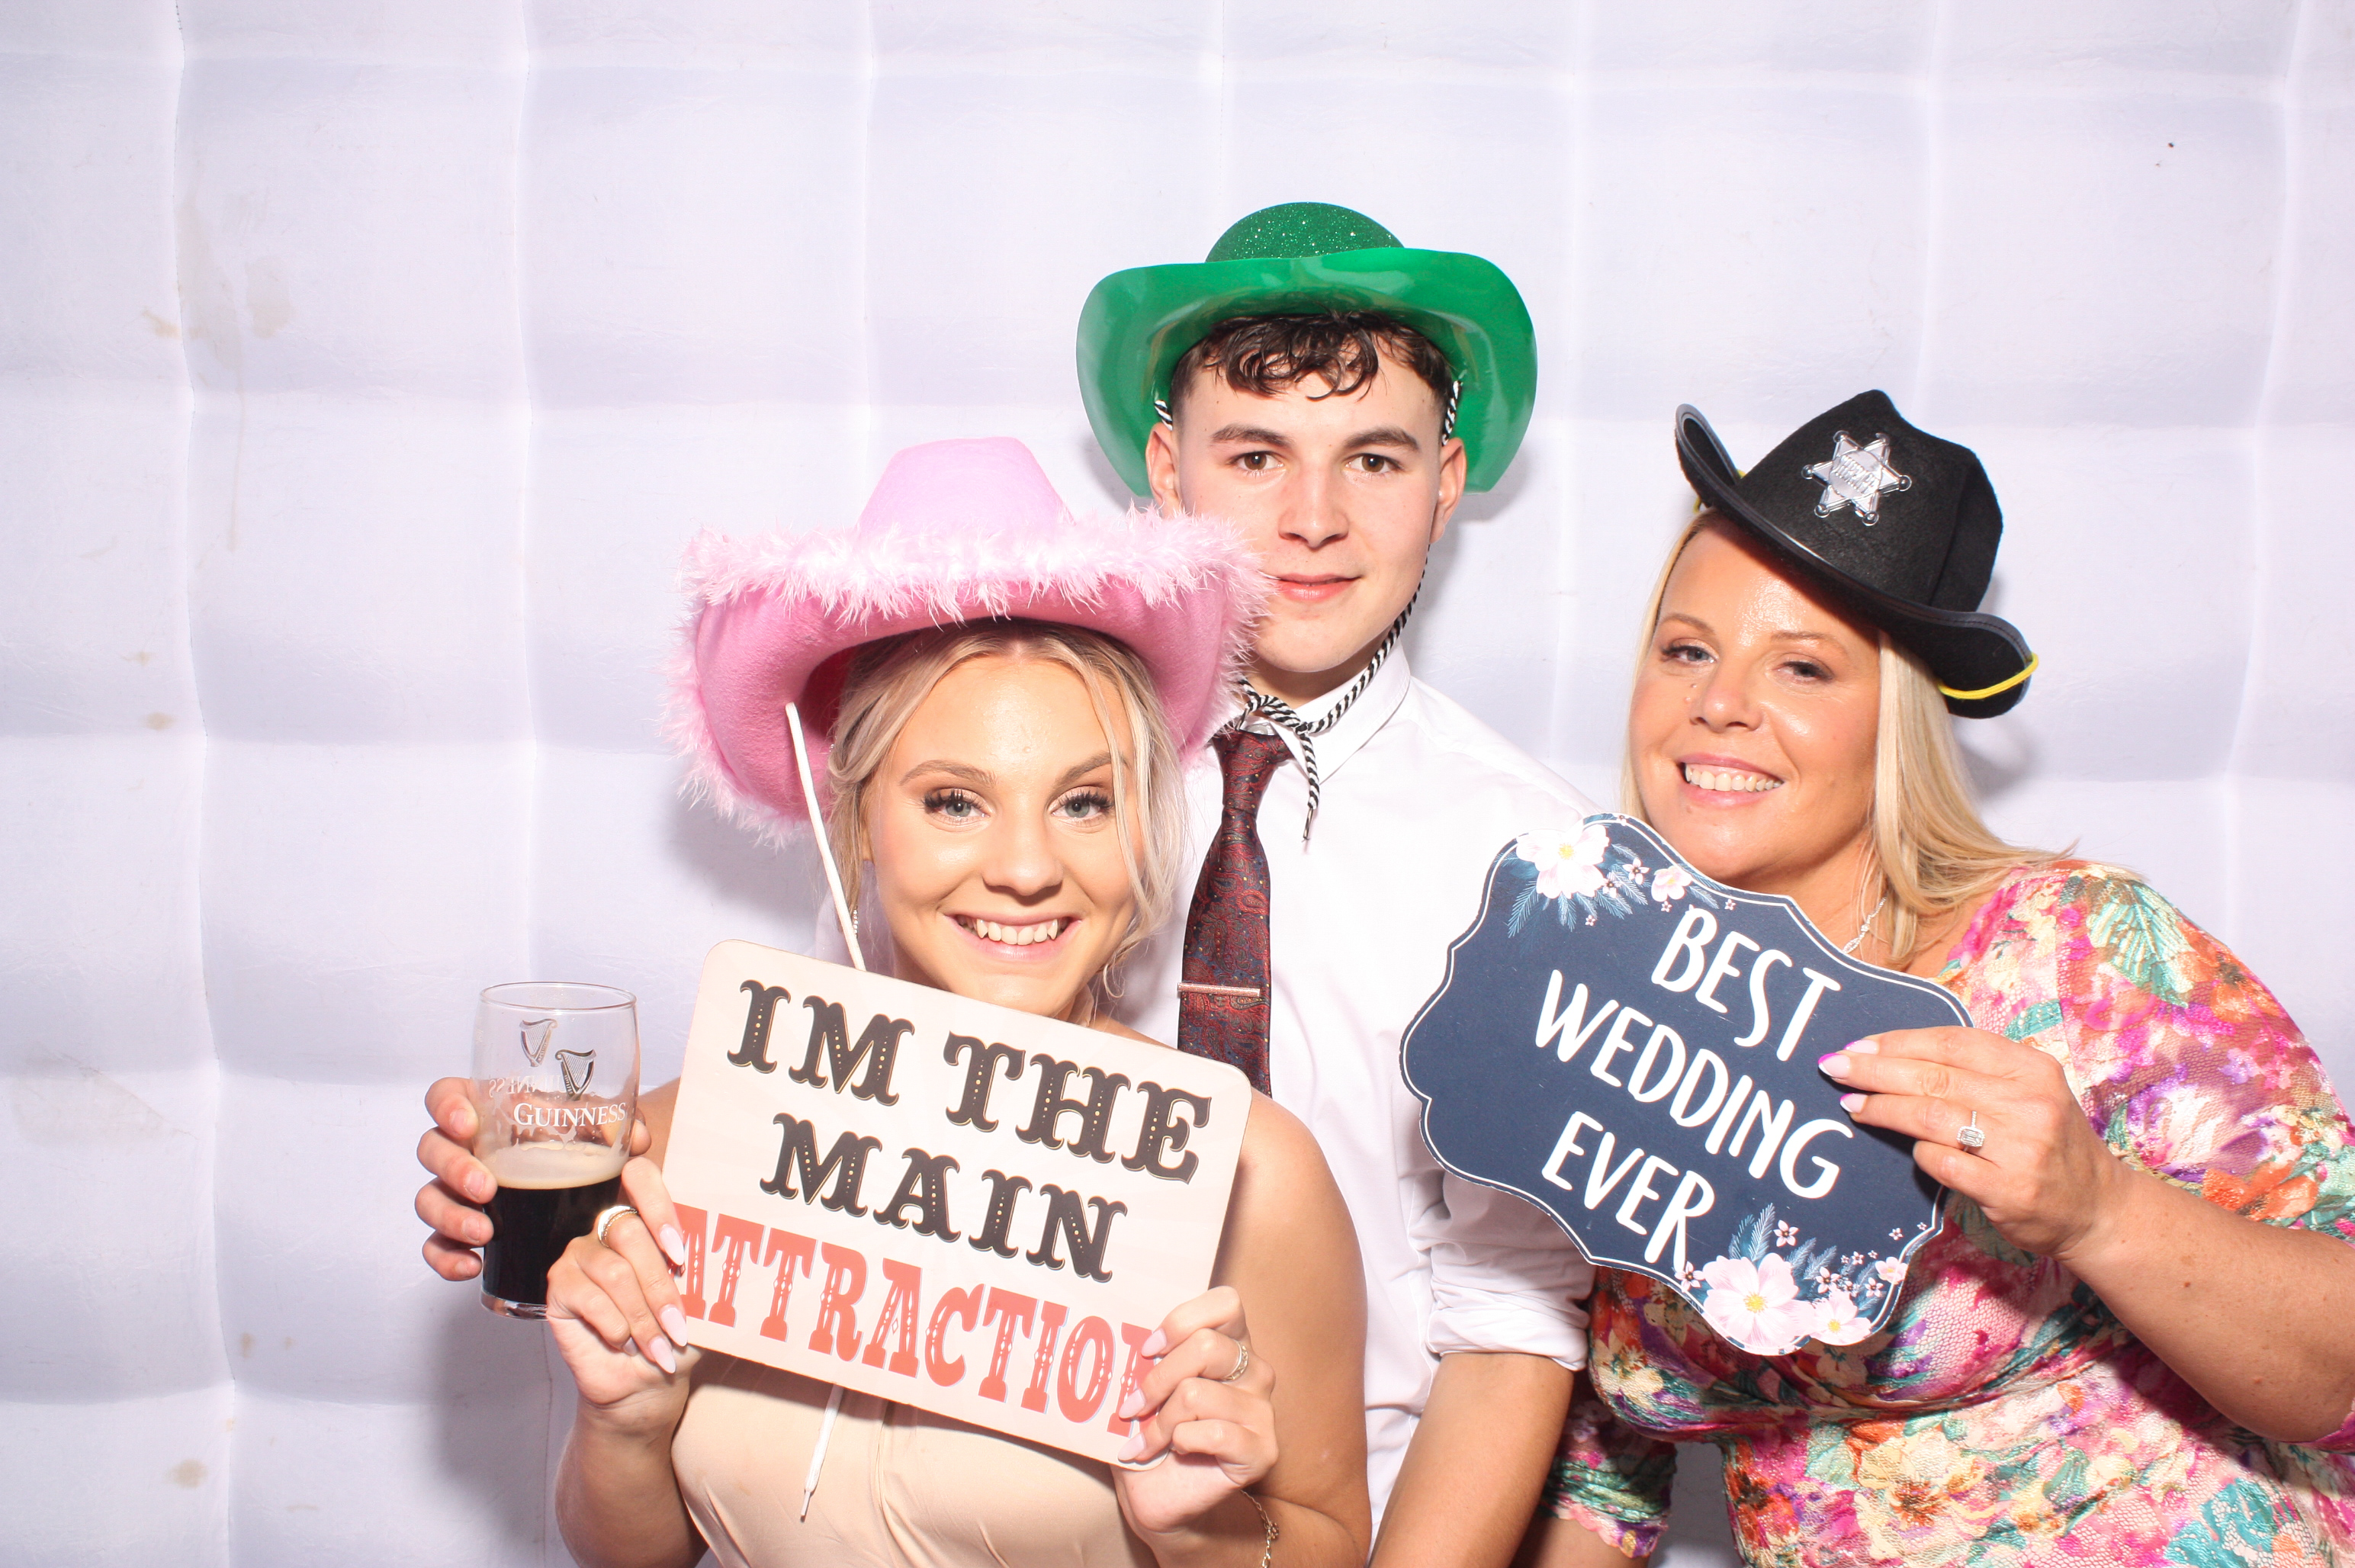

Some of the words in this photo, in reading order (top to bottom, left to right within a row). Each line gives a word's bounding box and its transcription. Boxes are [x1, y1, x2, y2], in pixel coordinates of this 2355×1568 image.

[1651, 907, 1841, 1062] BEST
[513, 1102, 626, 1127] GUINNESS
[727, 979, 915, 1107] IM
[943, 1030, 1212, 1184] THE
[1534, 969, 1853, 1199] WEDDING
[760, 1113, 1127, 1282] MAIN
[1541, 1111, 1715, 1267] EVER
